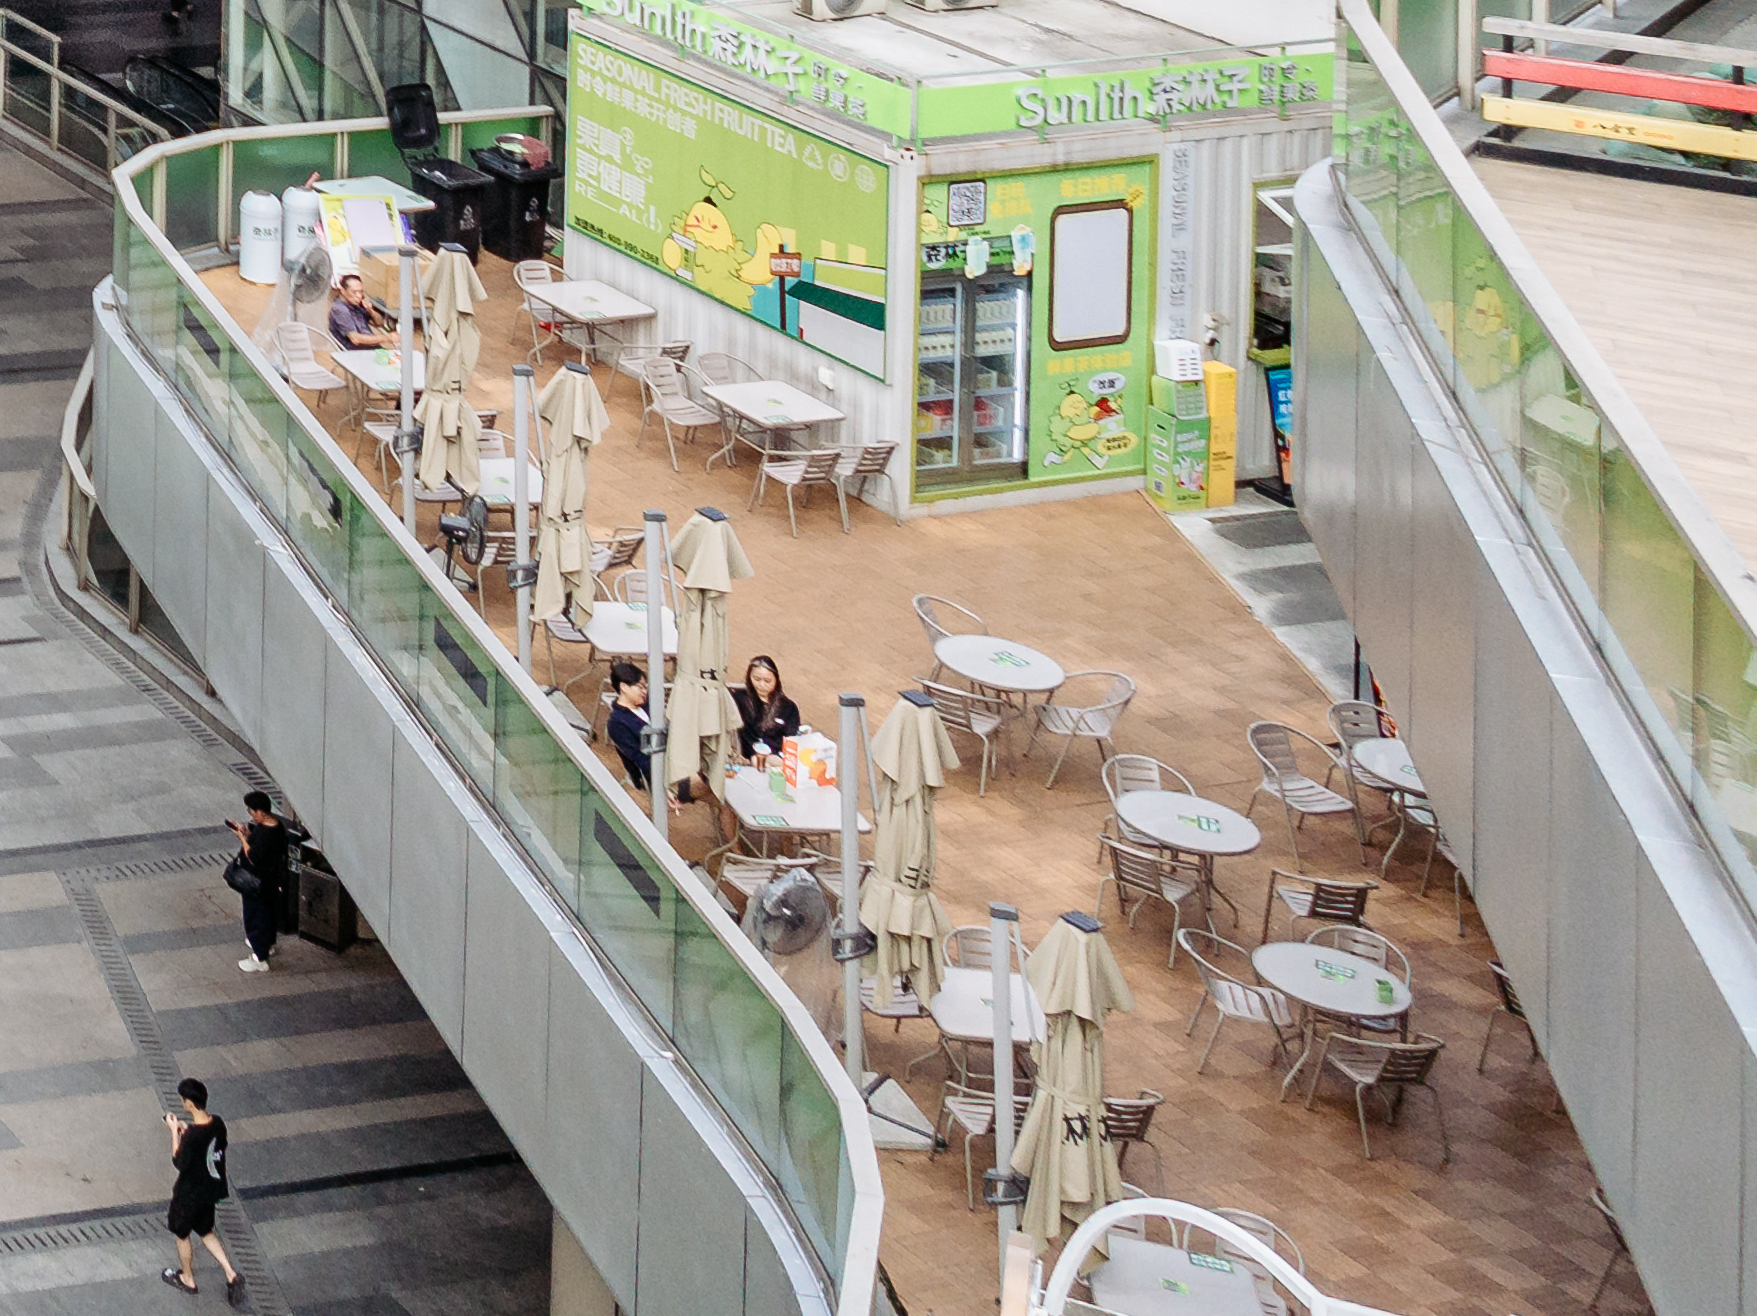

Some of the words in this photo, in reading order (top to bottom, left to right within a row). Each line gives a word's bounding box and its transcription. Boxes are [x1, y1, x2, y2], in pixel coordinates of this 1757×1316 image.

[576, 42, 660, 99] SEASONAL
[660, 79, 712, 121] FRESH
[709, 20, 805, 92] 森林子
[576, 70, 698, 141] 时令鲜果茶开创者
[1149, 65, 1252, 116] 森林子
[575, 115, 623, 164] 果真
[574, 147, 646, 210] 更健康
